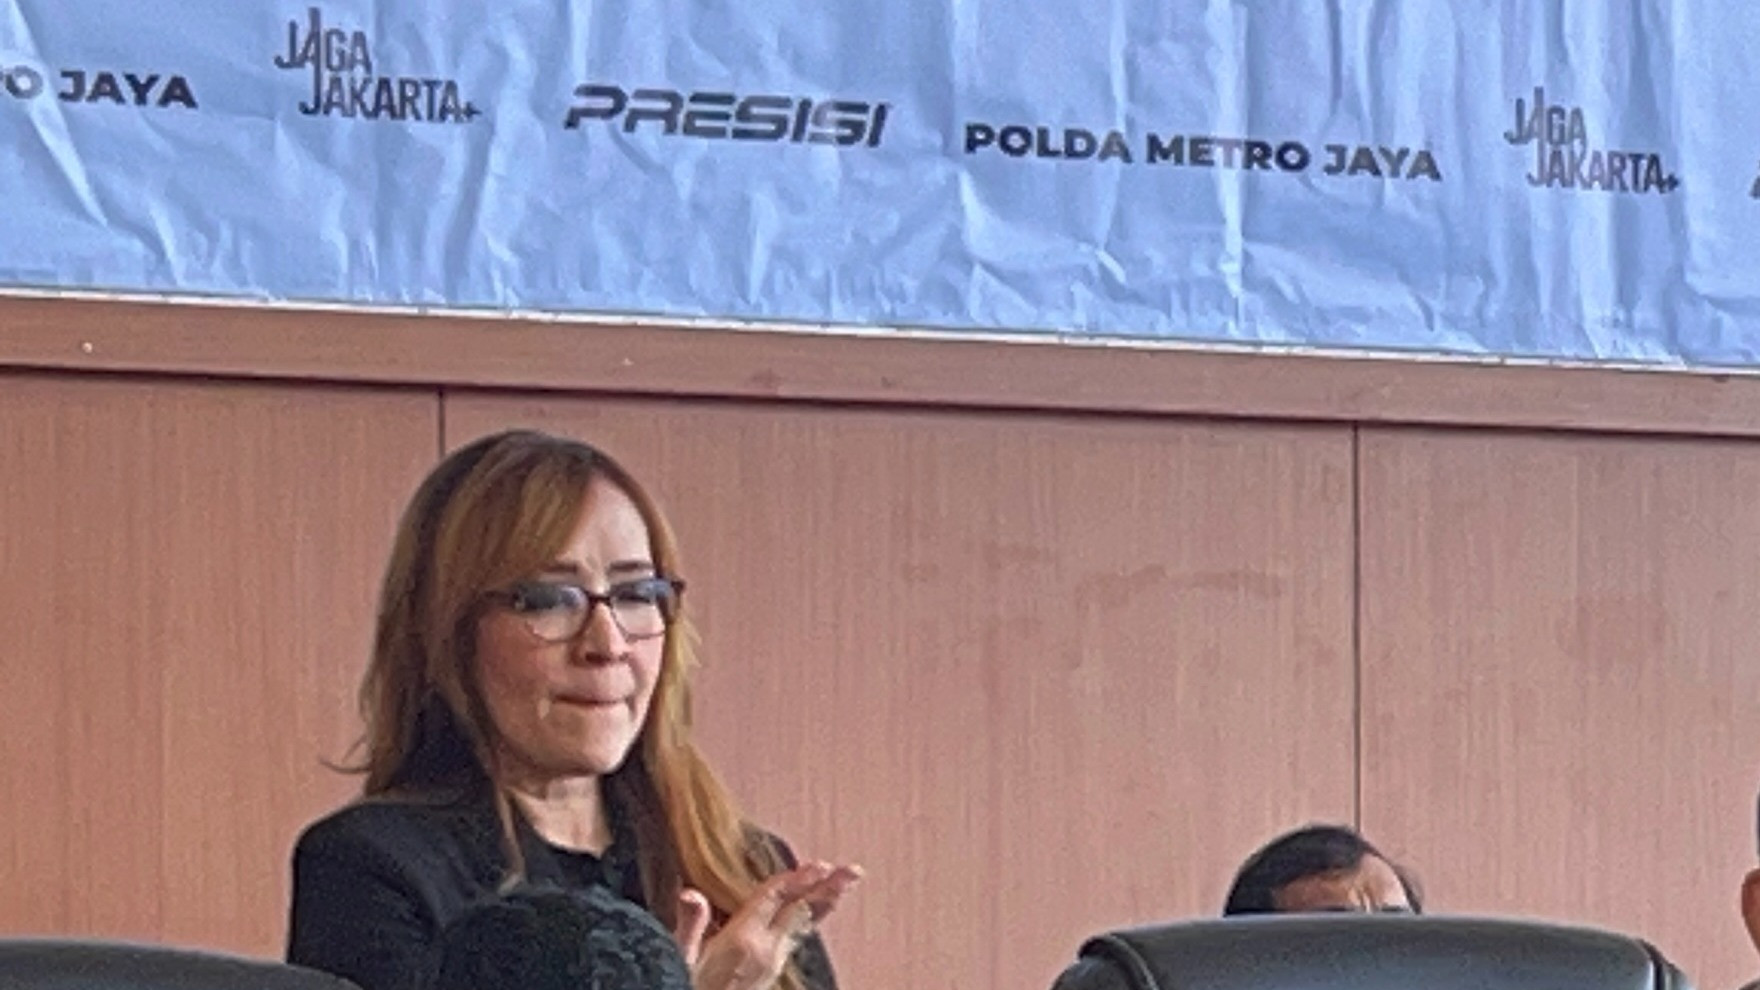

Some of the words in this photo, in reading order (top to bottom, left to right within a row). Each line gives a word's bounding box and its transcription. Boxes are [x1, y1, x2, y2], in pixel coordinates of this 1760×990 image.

[274, 7, 373, 75] JAGA
[58, 70, 198, 109] JAYA
[564, 85, 894, 148] PRESISI
[1504, 86, 1587, 146] JAGA
[965, 124, 1132, 164] POLDA
[1146, 134, 1311, 173] METRO
[1323, 145, 1442, 182] JAYA
